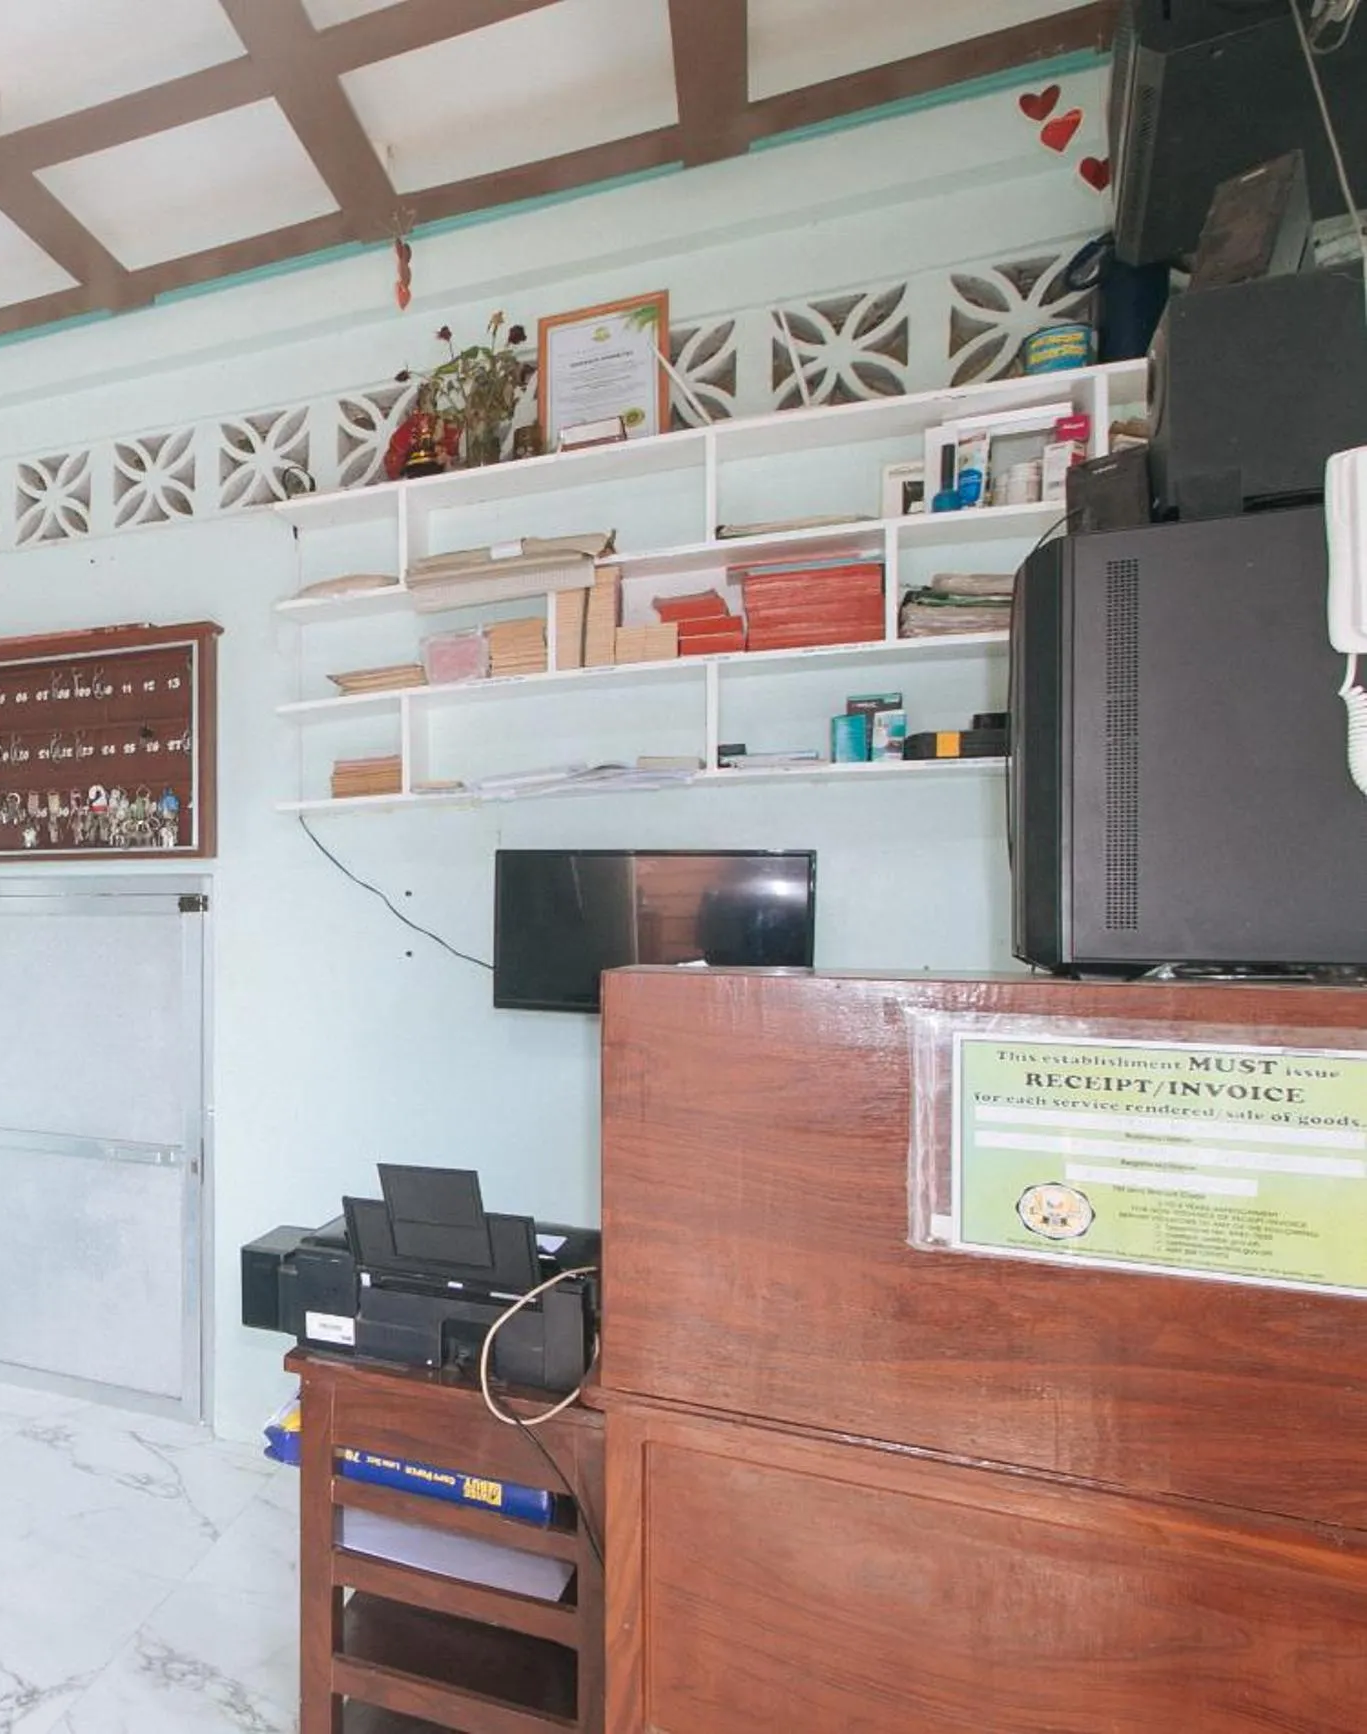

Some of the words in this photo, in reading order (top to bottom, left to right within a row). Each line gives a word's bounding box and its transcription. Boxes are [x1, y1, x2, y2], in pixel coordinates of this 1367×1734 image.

[996, 1050, 1037, 1063] This
[1042, 1053, 1183, 1070] establishment
[1188, 1056, 1280, 1076] MUST
[1285, 1064, 1340, 1079] issue
[1024, 1072, 1306, 1104] RECEIPT/INVOICE
[973, 1091, 1003, 1103] for
[1007, 1095, 1047, 1106] each
[1052, 1098, 1121, 1111] service
[1271, 1110, 1291, 1123] of
